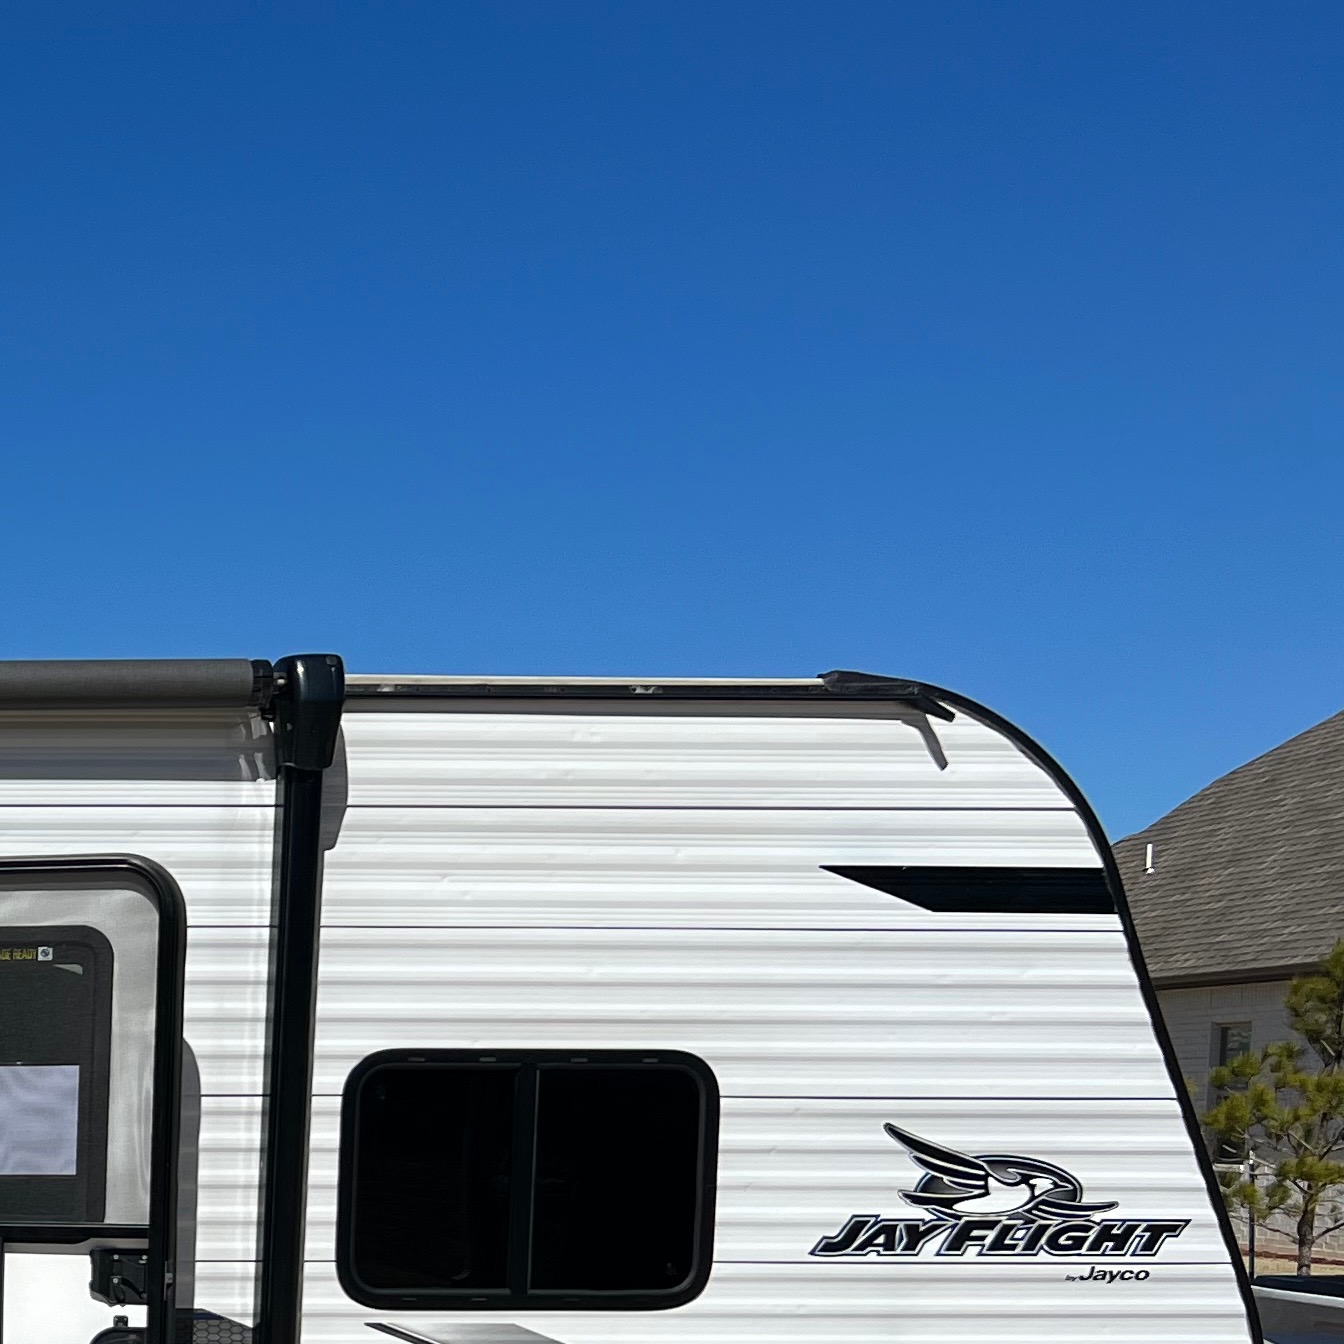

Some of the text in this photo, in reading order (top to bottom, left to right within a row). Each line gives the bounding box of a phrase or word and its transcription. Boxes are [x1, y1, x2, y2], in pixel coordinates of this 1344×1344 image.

[809, 1213, 1193, 1258] JAY FLIGHT
[1078, 1265, 1150, 1285] Jayco
